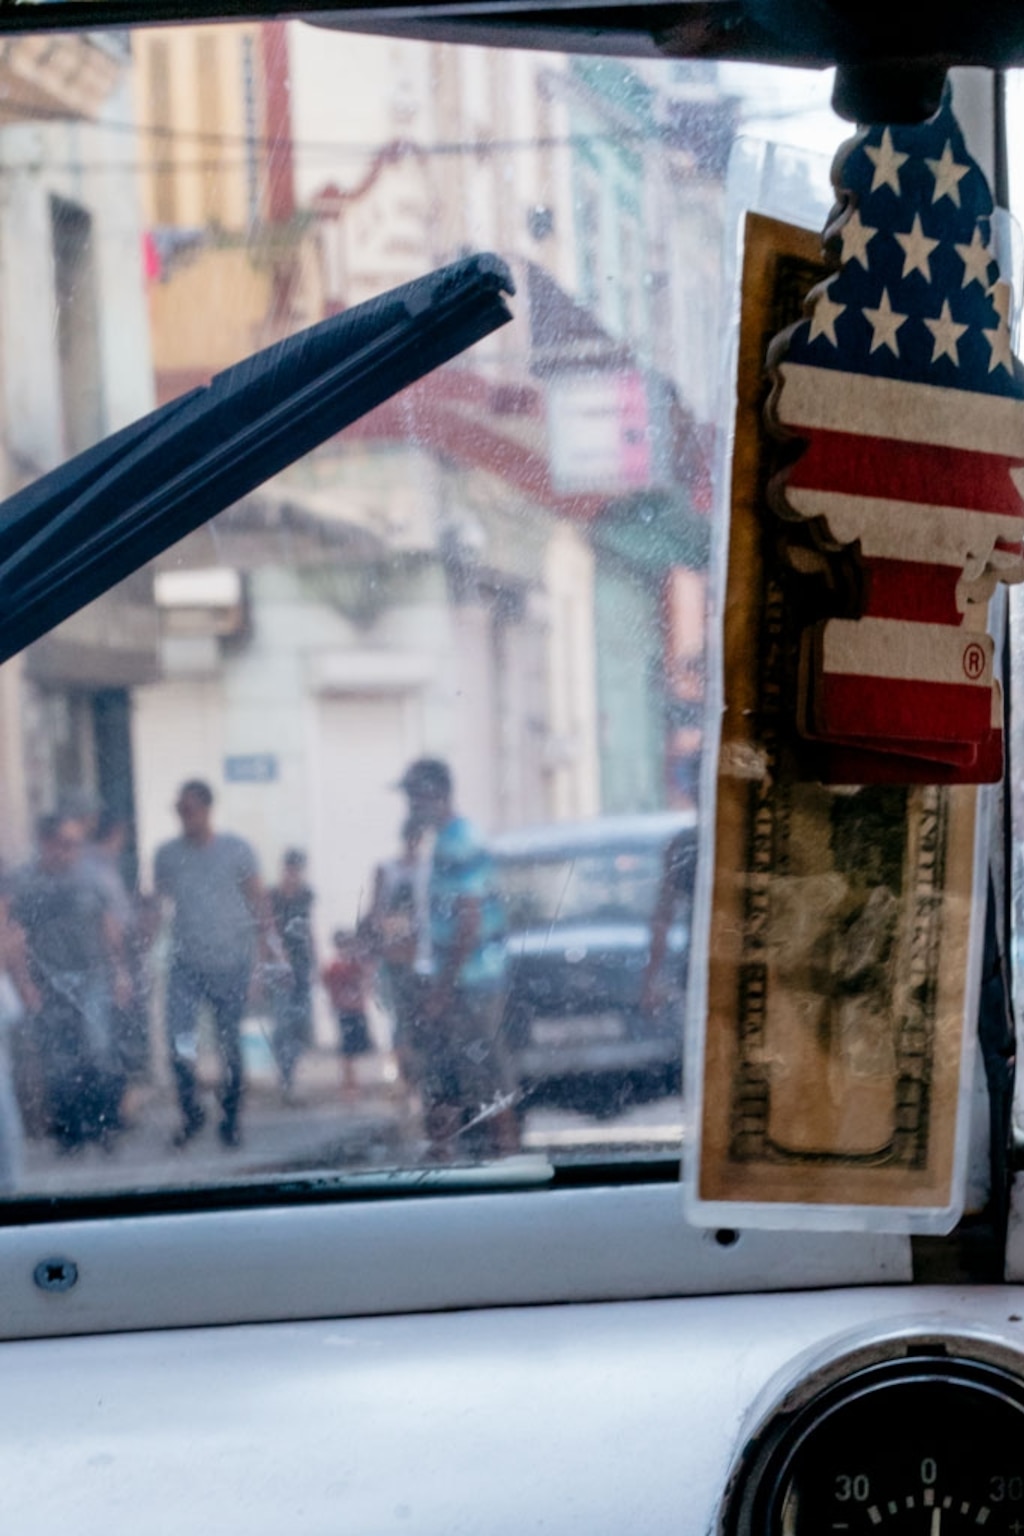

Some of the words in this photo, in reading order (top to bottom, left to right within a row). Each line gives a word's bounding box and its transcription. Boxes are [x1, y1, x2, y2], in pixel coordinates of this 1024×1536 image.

[920, 1457, 938, 1485] 0
[834, 1474, 870, 1502] 30
[988, 1475, 1024, 1502] 30
